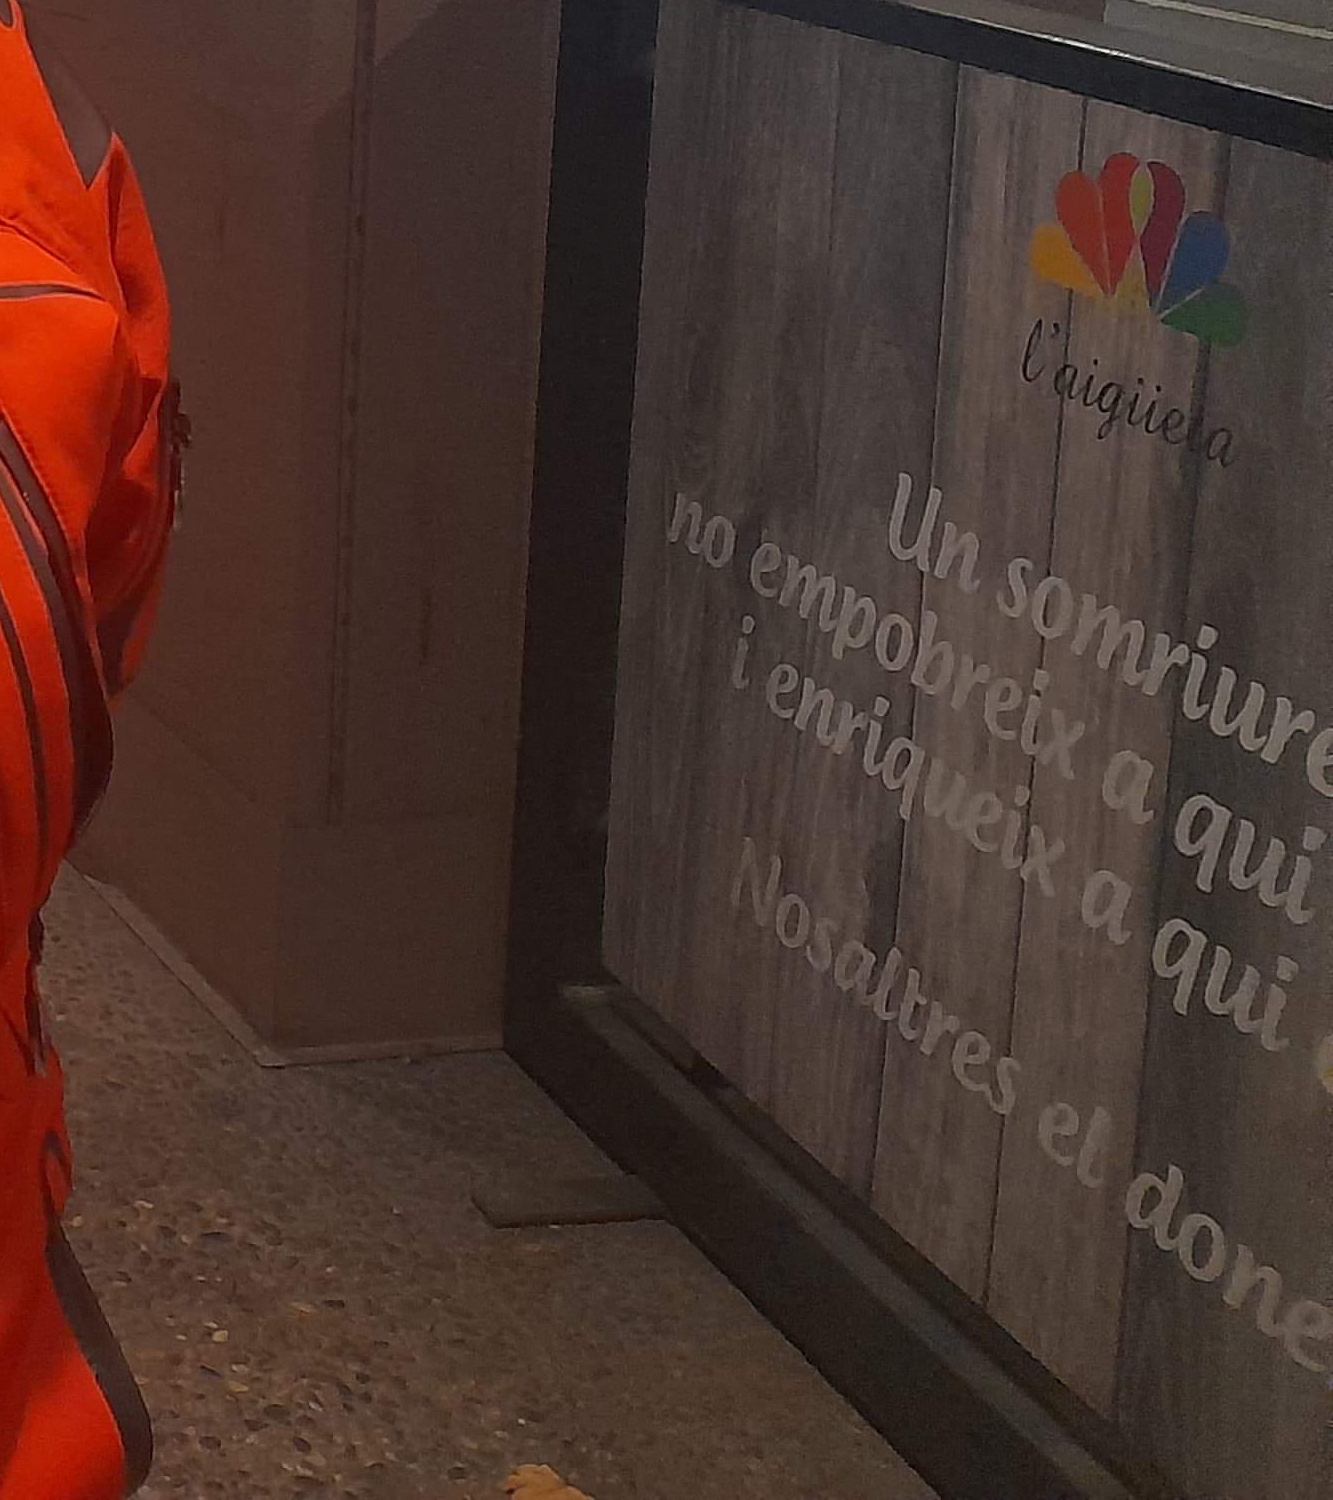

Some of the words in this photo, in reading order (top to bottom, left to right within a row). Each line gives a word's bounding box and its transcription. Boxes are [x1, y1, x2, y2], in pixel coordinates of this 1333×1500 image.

[887, 472, 981, 591] Un
[1020, 318, 1237, 467] l'aigüea
[666, 491, 736, 569] no
[749, 538, 1086, 779] empobreix
[1102, 749, 1155, 824] a
[1173, 792, 1327, 925] qui
[729, 615, 756, 691] i
[765, 660, 1066, 897] enriqueix
[1081, 869, 1133, 945] a
[1152, 917, 1300, 1052] qui
[730, 836, 1023, 1116] Nosaltres
[1037, 1100, 1113, 1189] el
